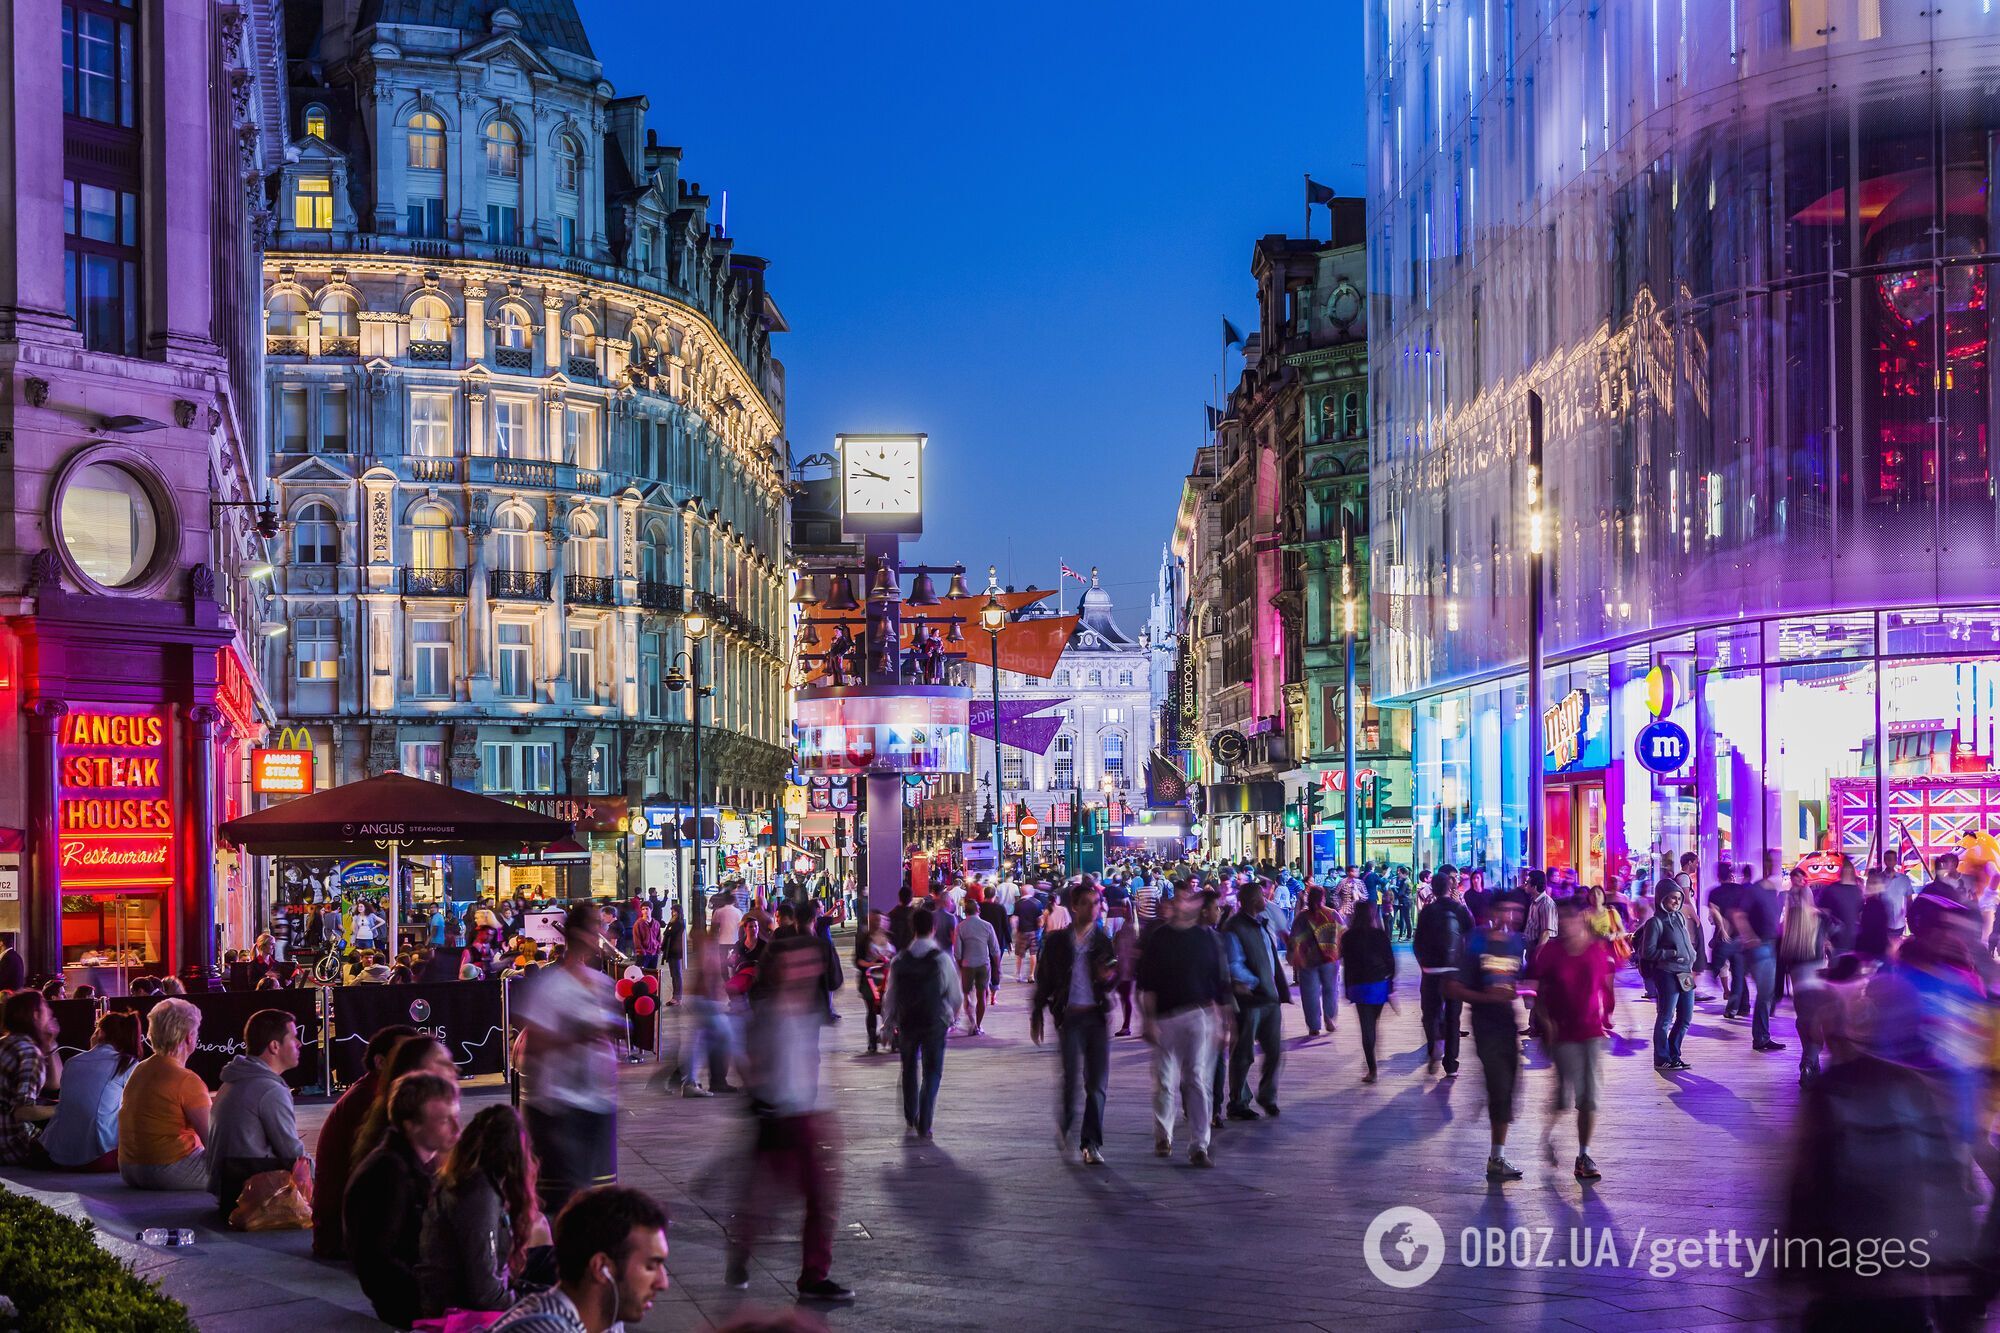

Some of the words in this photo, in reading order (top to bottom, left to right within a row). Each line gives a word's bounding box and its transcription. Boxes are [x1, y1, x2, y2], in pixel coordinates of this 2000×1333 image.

[1183, 653, 1193, 714] TROCADERO
[74, 715, 162, 746] ANGUS
[1652, 736, 1681, 757] m
[263, 754, 302, 765] ANGUS
[76, 757, 161, 787] STEAK
[265, 766, 299, 777] STEAK
[69, 799, 171, 829] HOUSES
[360, 823, 405, 834] ANGUS
[63, 841, 167, 866] Restaurant
[0, 881, 11, 889] C2
